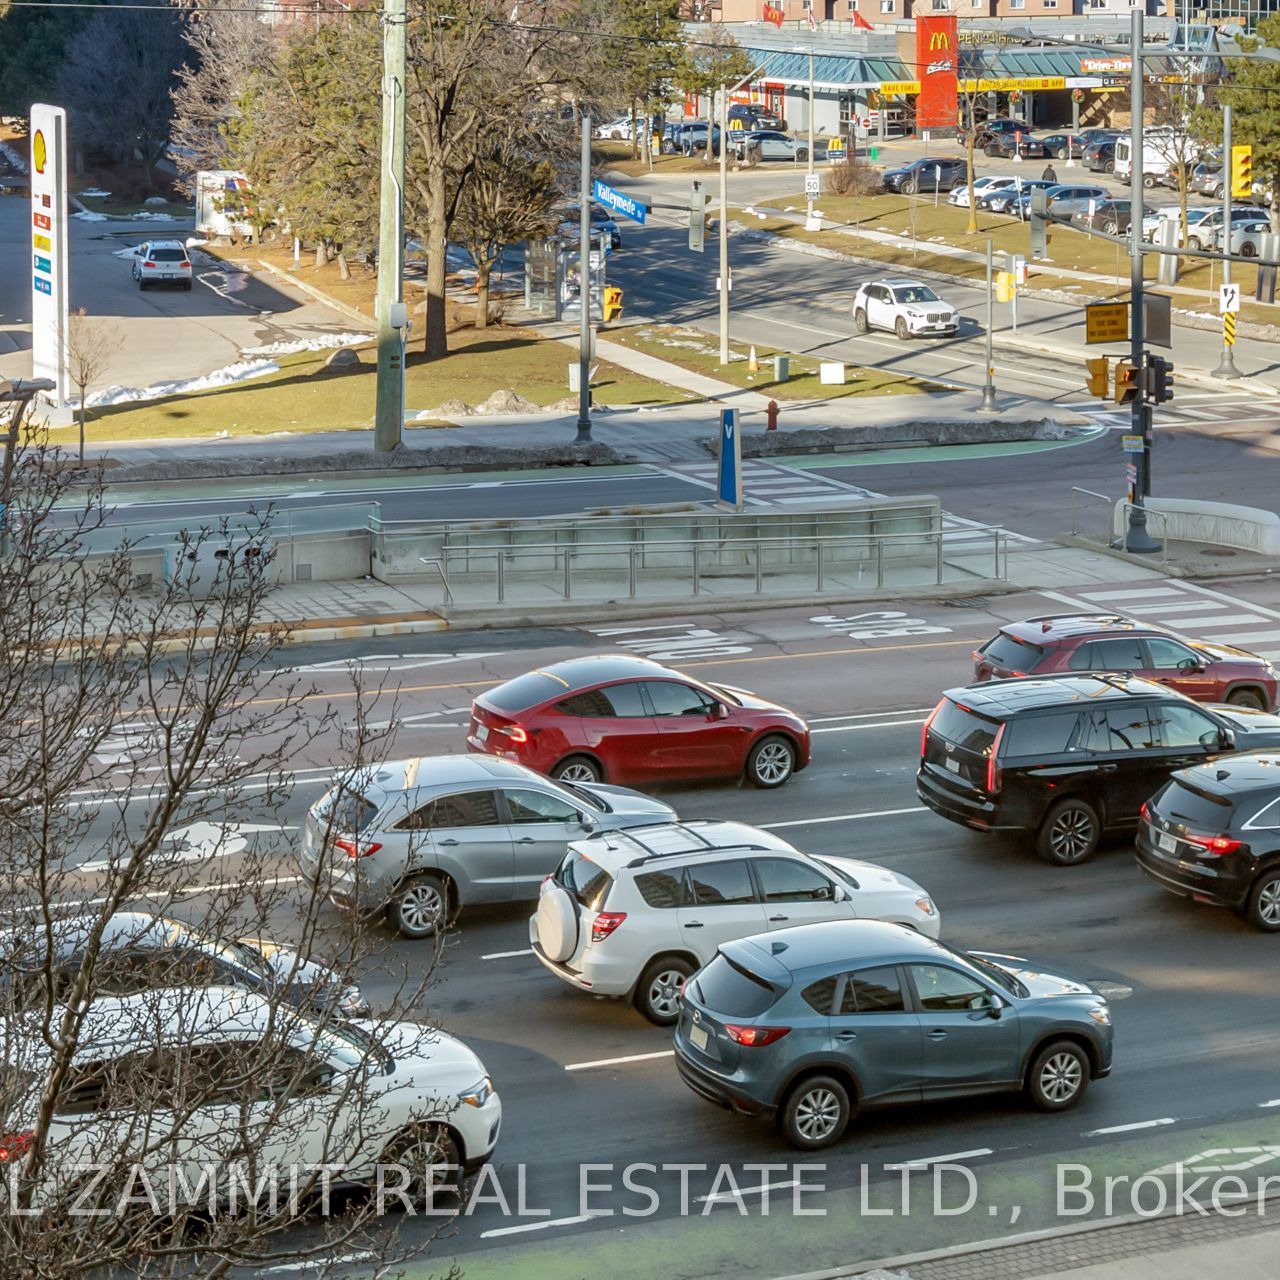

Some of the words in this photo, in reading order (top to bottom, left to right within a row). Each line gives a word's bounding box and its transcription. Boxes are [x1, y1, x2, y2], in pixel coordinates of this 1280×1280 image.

[958, 33, 980, 44] PEN
[807, 182, 818, 190] 50
[597, 183, 636, 216] Valleymede
